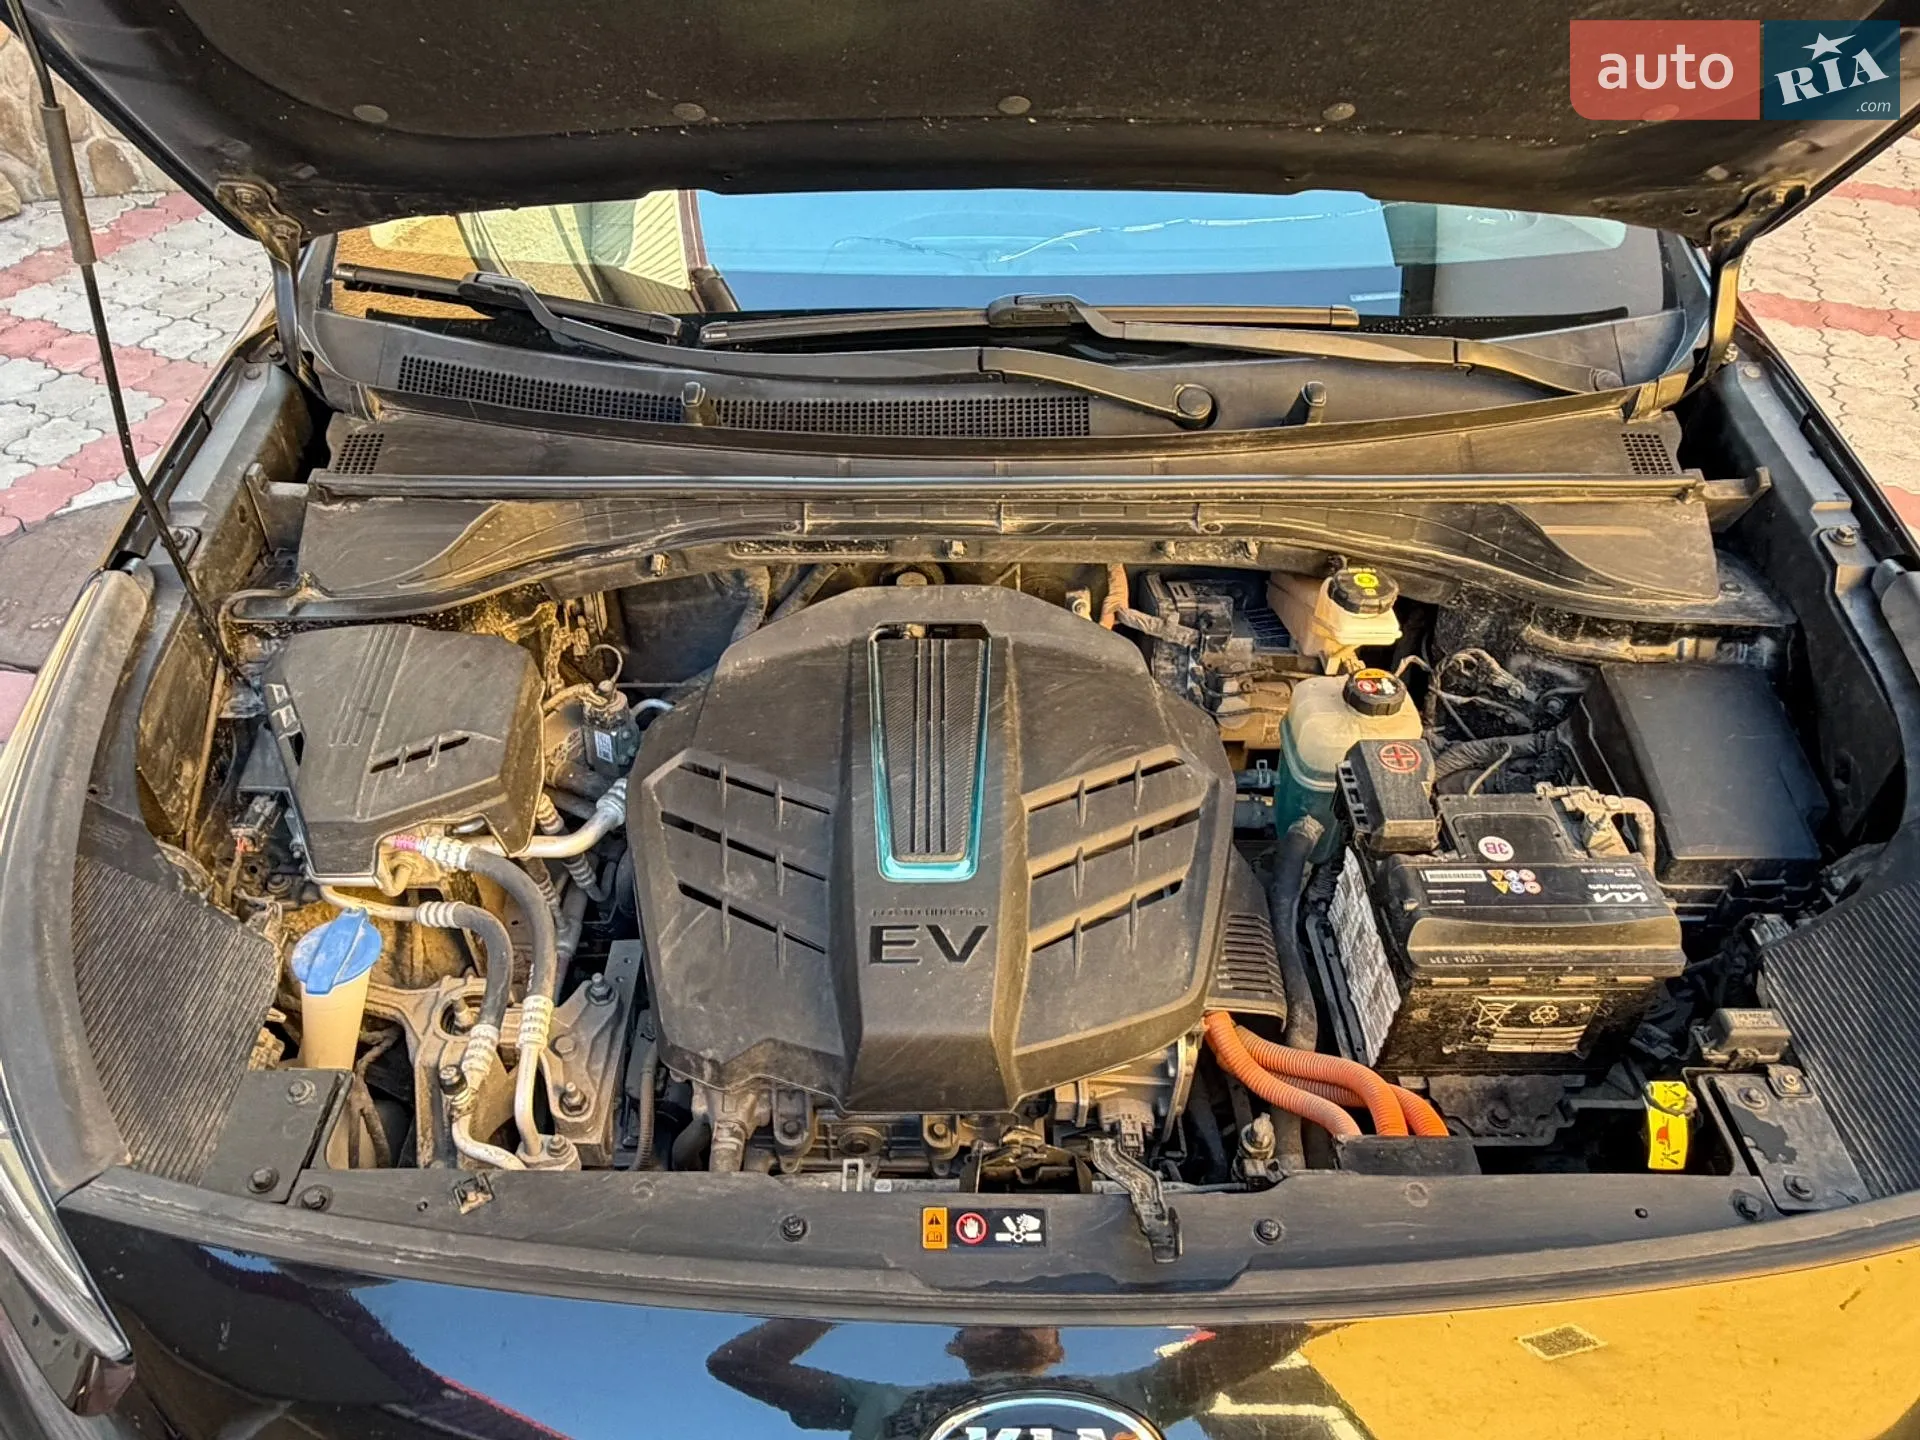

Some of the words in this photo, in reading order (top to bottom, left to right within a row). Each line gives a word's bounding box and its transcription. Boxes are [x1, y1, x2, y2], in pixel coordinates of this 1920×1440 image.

[1484, 842, 1509, 855] 3B
[1593, 891, 1649, 903] KIA
[869, 924, 991, 965] EV
